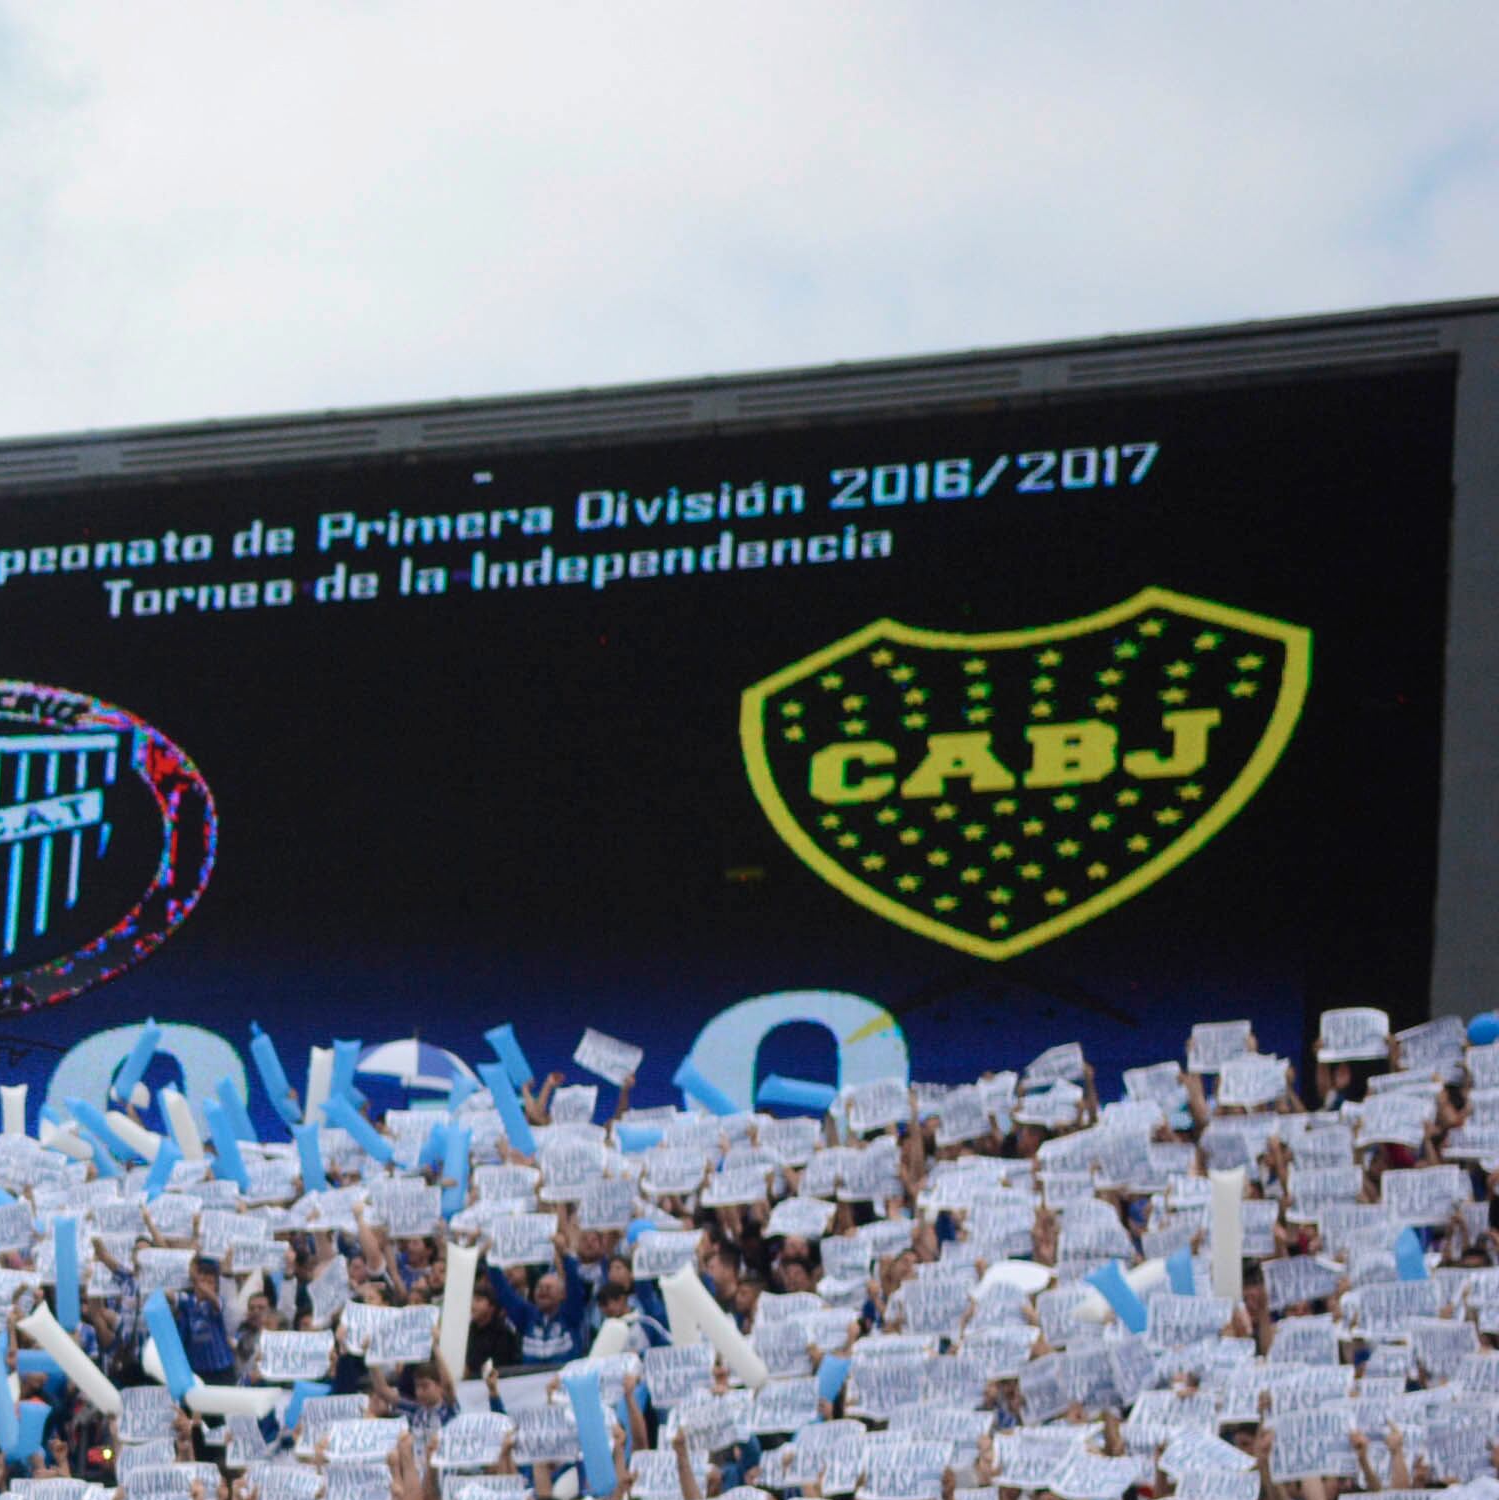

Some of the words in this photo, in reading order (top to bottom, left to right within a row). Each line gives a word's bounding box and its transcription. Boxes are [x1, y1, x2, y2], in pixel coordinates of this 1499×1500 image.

[233, 520, 295, 559] de
[317, 504, 553, 552] Primera
[576, 480, 805, 532] División
[829, 441, 1159, 510] 2016/2017
[103, 575, 294, 619] Torneo
[315, 562, 378, 602] de
[400, 555, 447, 596] la
[470, 525, 893, 590] Independencia
[810, 708, 1222, 804] CABJ
